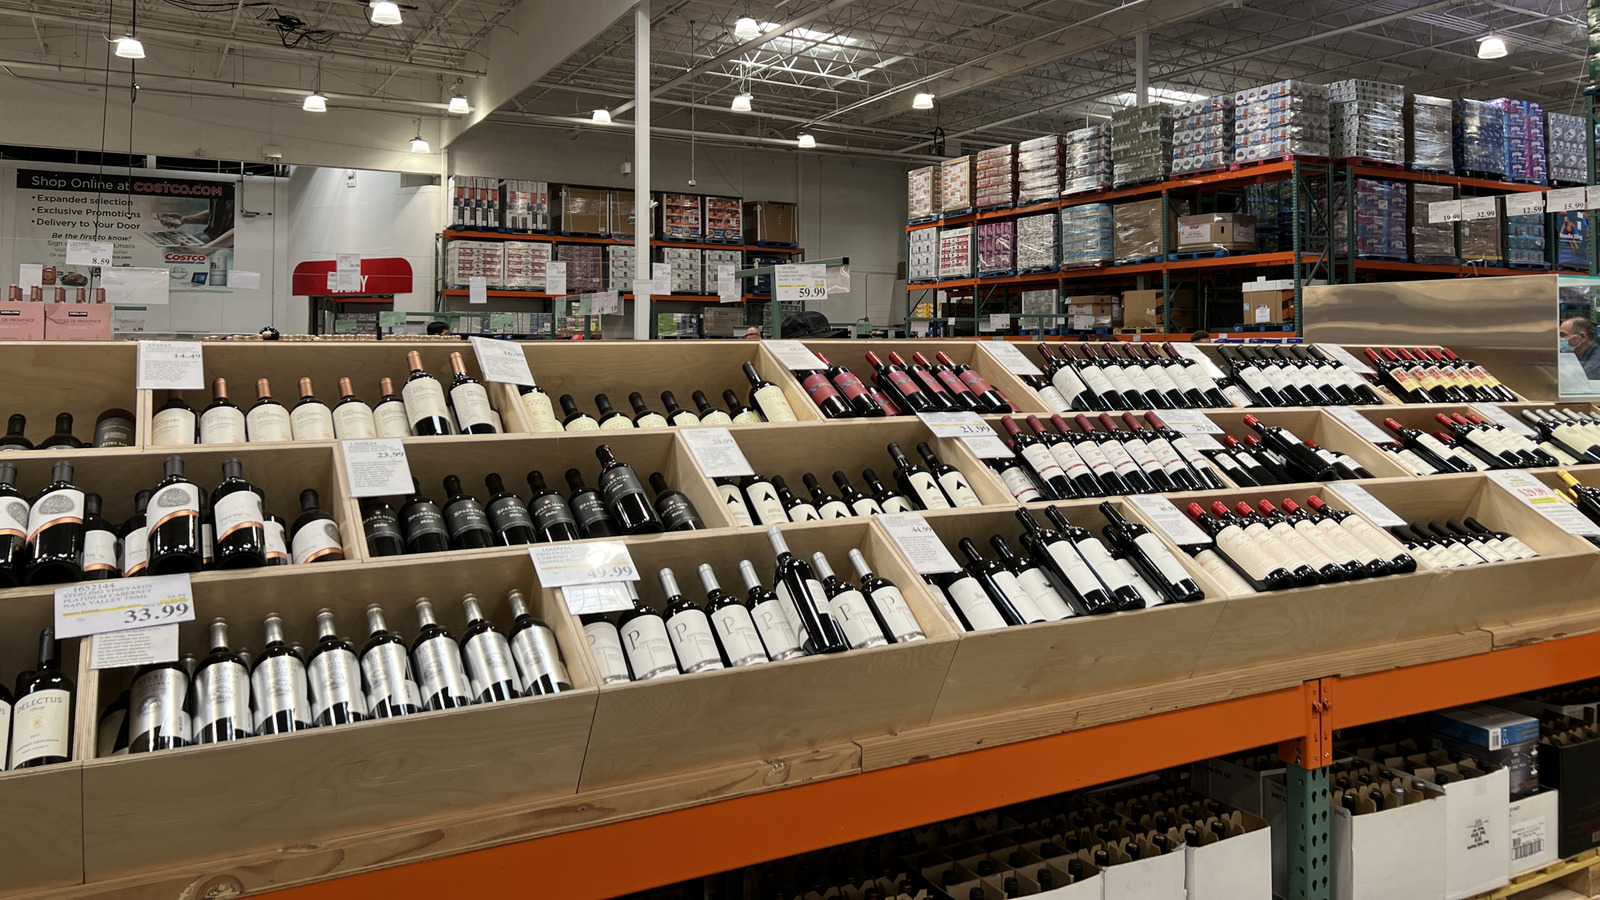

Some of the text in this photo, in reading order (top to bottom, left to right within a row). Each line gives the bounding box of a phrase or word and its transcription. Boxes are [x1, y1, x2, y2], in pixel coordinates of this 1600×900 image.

[32, 176, 223, 196] Shop Online at COSTCO.COM
[37, 194, 133, 206] Expanded selection
[37, 206, 141, 218] Exclusive Promotions
[36, 218, 76, 228] Delivery
[93, 220, 114, 229] Your
[117, 222, 140, 230] Door
[164, 252, 206, 262] COSTCO
[799, 287, 826, 298] 59.99
[587, 566, 632, 578] 49.99
[64, 584, 152, 598] STERLING VINEYARDS
[64, 588, 152, 603] PLATINUM CABERNET
[74, 583, 115, 592] 1652144
[124, 603, 189, 623] 33.99
[839, 602, 850, 622] P
[882, 596, 895, 614] P
[720, 616, 735, 636] P
[760, 612, 772, 631] P
[627, 630, 640, 651] P
[674, 622, 686, 643] P
[17, 697, 62, 714] DELECTUS
